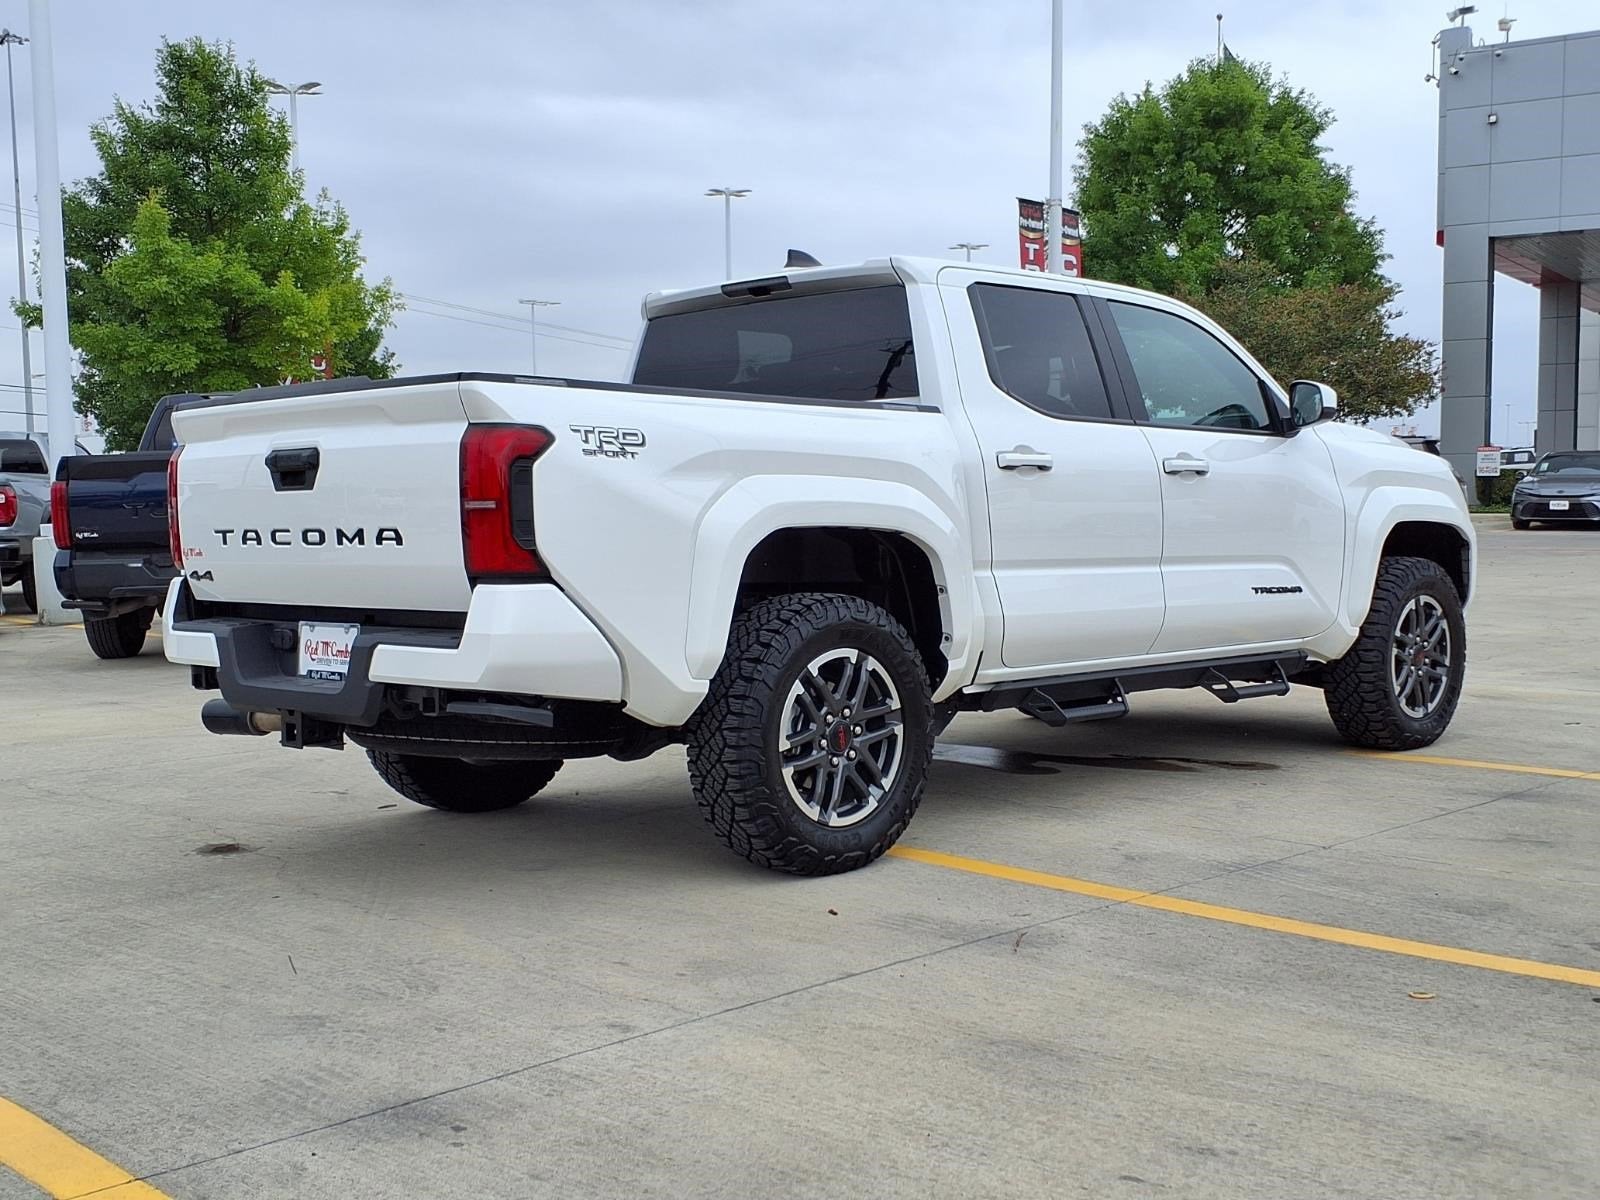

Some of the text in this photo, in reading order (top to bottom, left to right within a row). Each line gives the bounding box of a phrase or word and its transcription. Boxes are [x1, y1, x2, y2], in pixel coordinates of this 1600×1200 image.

[568, 424, 647, 449] TRD
[581, 448, 639, 460] SPORT
[213, 527, 404, 547] TACOMA
[1251, 586, 1303, 594] TACOMA
[304, 638, 320, 662] Red
